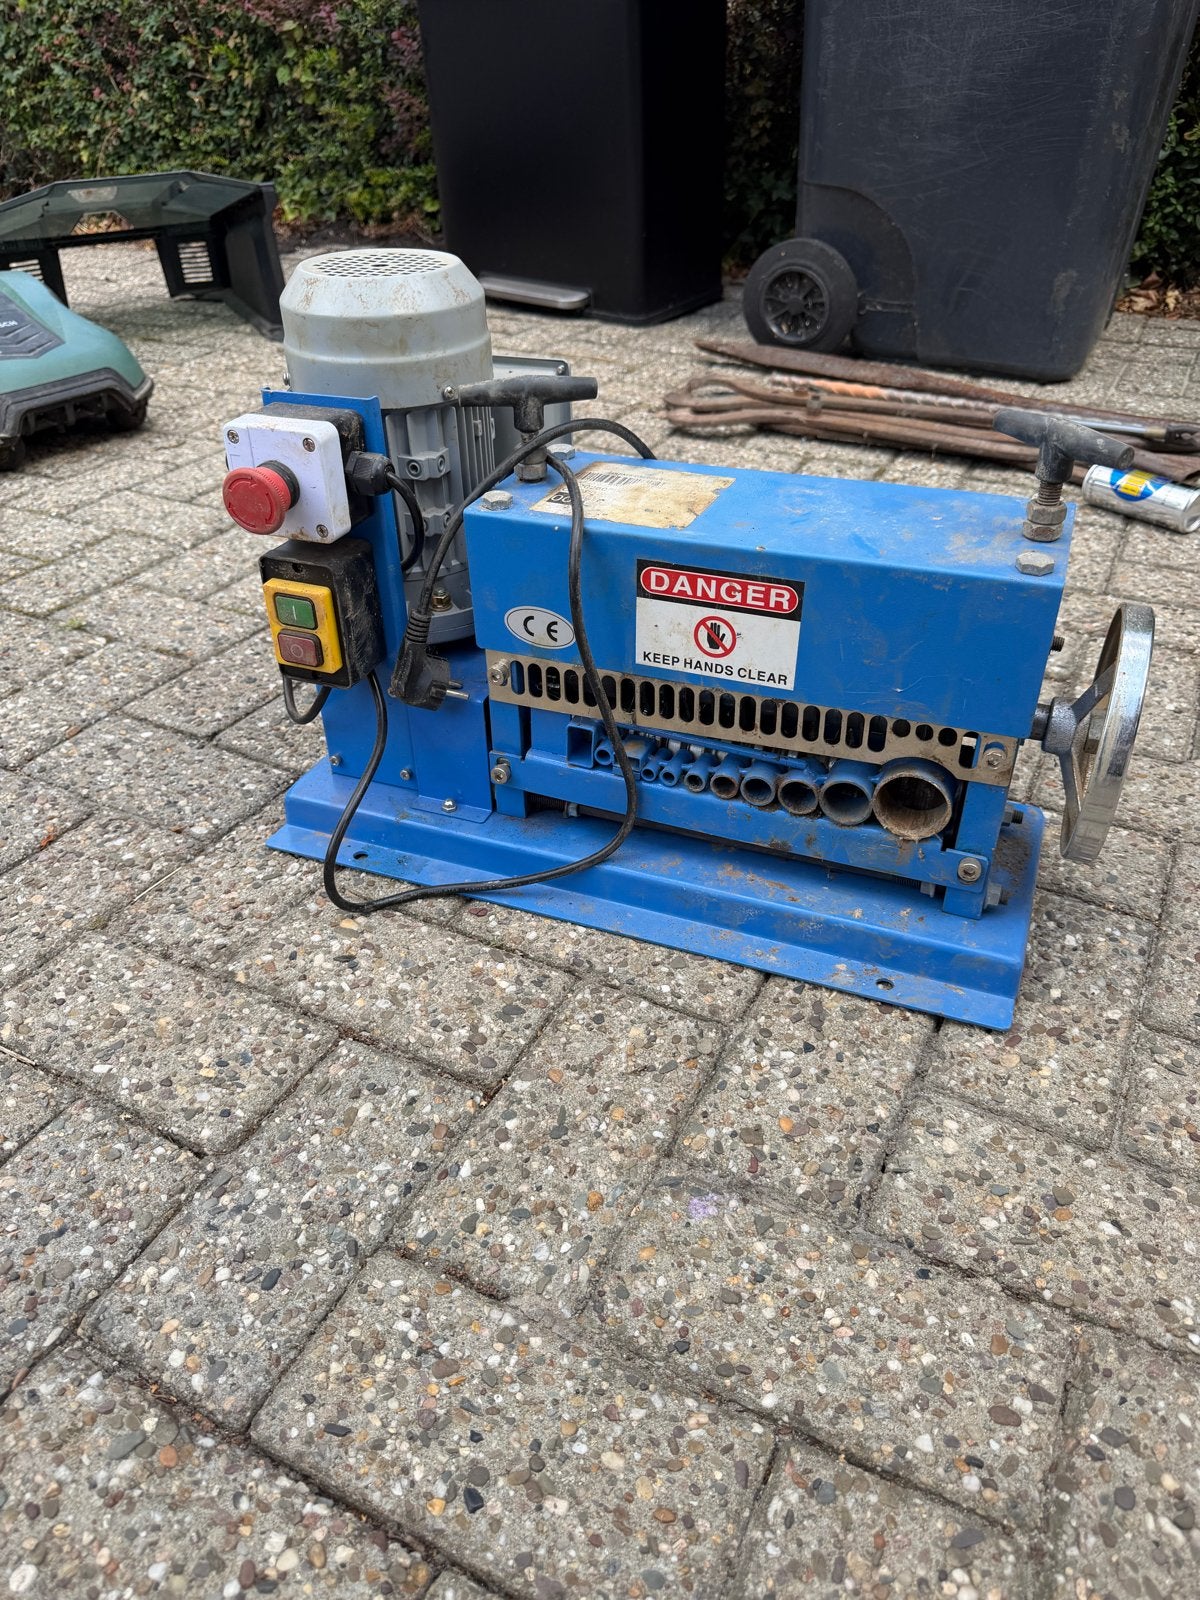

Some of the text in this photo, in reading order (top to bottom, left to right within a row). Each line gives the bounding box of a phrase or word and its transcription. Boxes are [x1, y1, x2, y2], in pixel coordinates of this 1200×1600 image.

[650, 570, 791, 610] DANGER
[523, 615, 558, 642] CE
[643, 651, 788, 686] KEEP HANDS CLEAR
